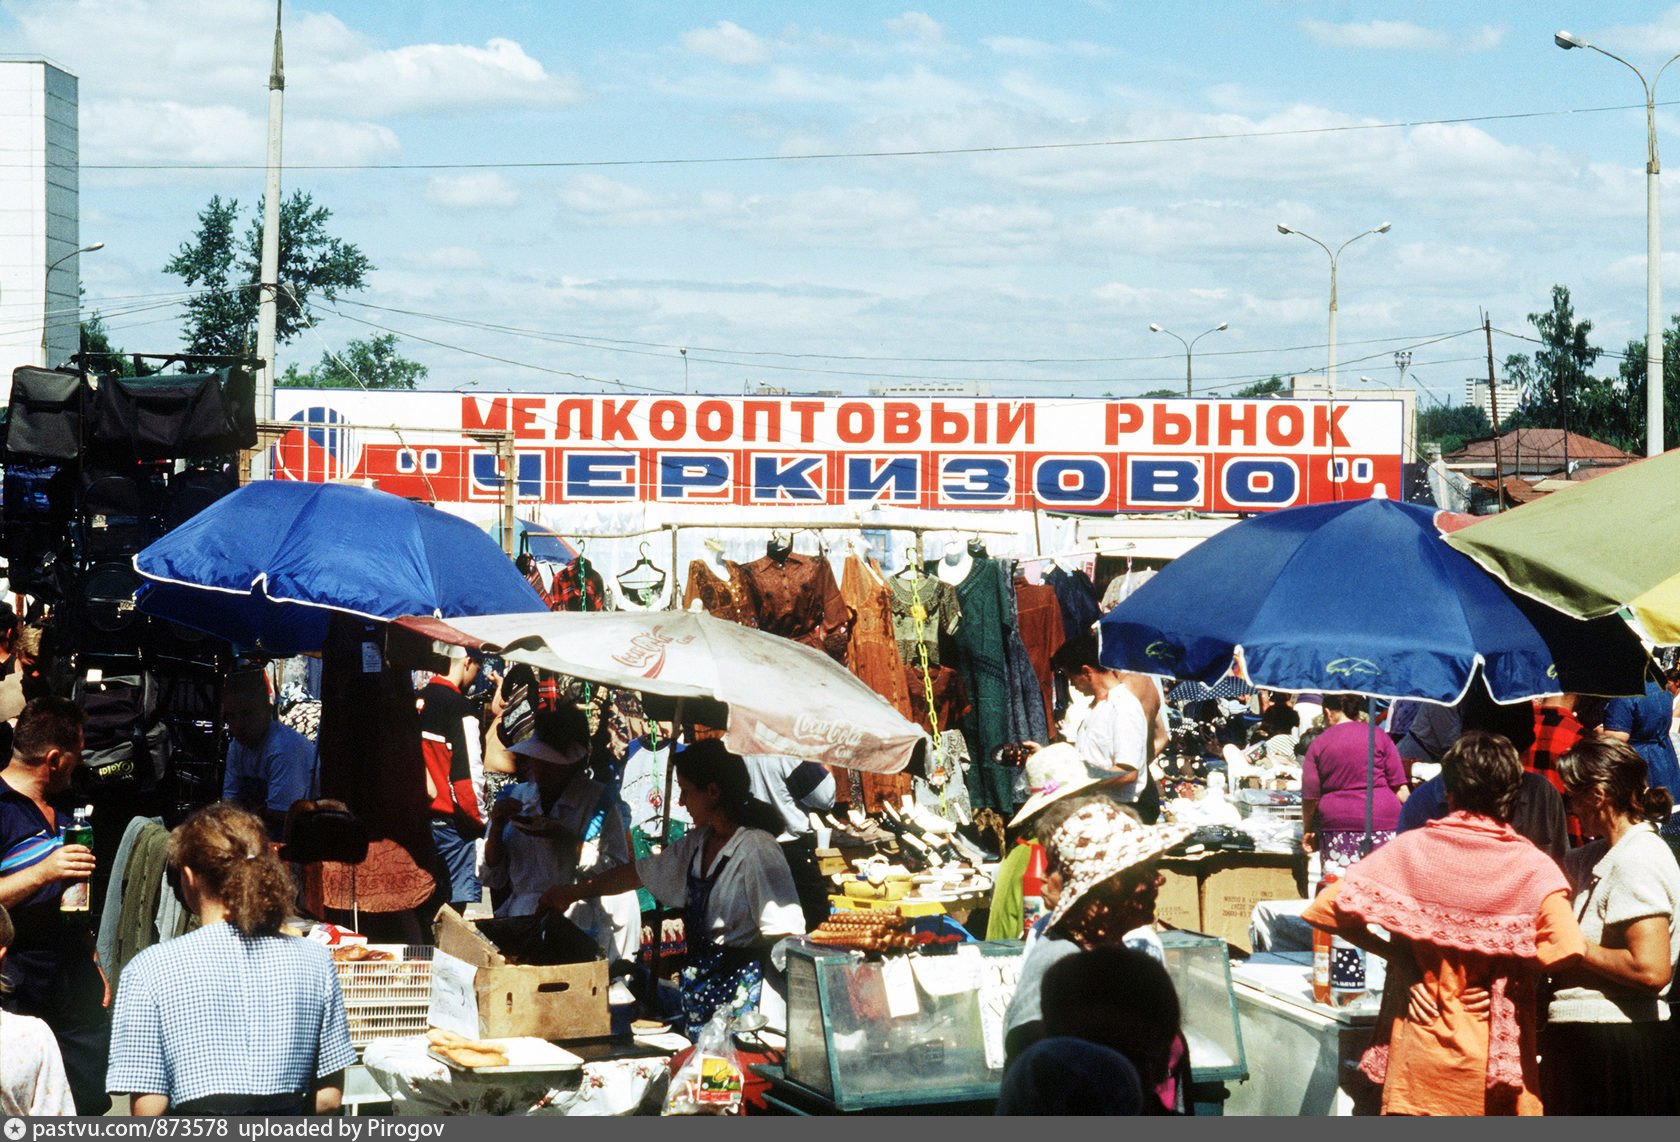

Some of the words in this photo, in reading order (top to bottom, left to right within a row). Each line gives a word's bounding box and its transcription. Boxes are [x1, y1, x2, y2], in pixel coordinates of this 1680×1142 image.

[461, 396, 1035, 445] МЕЛКООПТОВЫЙ
[1105, 403, 1352, 447] РЫНОК
[468, 448, 1300, 507] ЧЕРКИЗОВО
